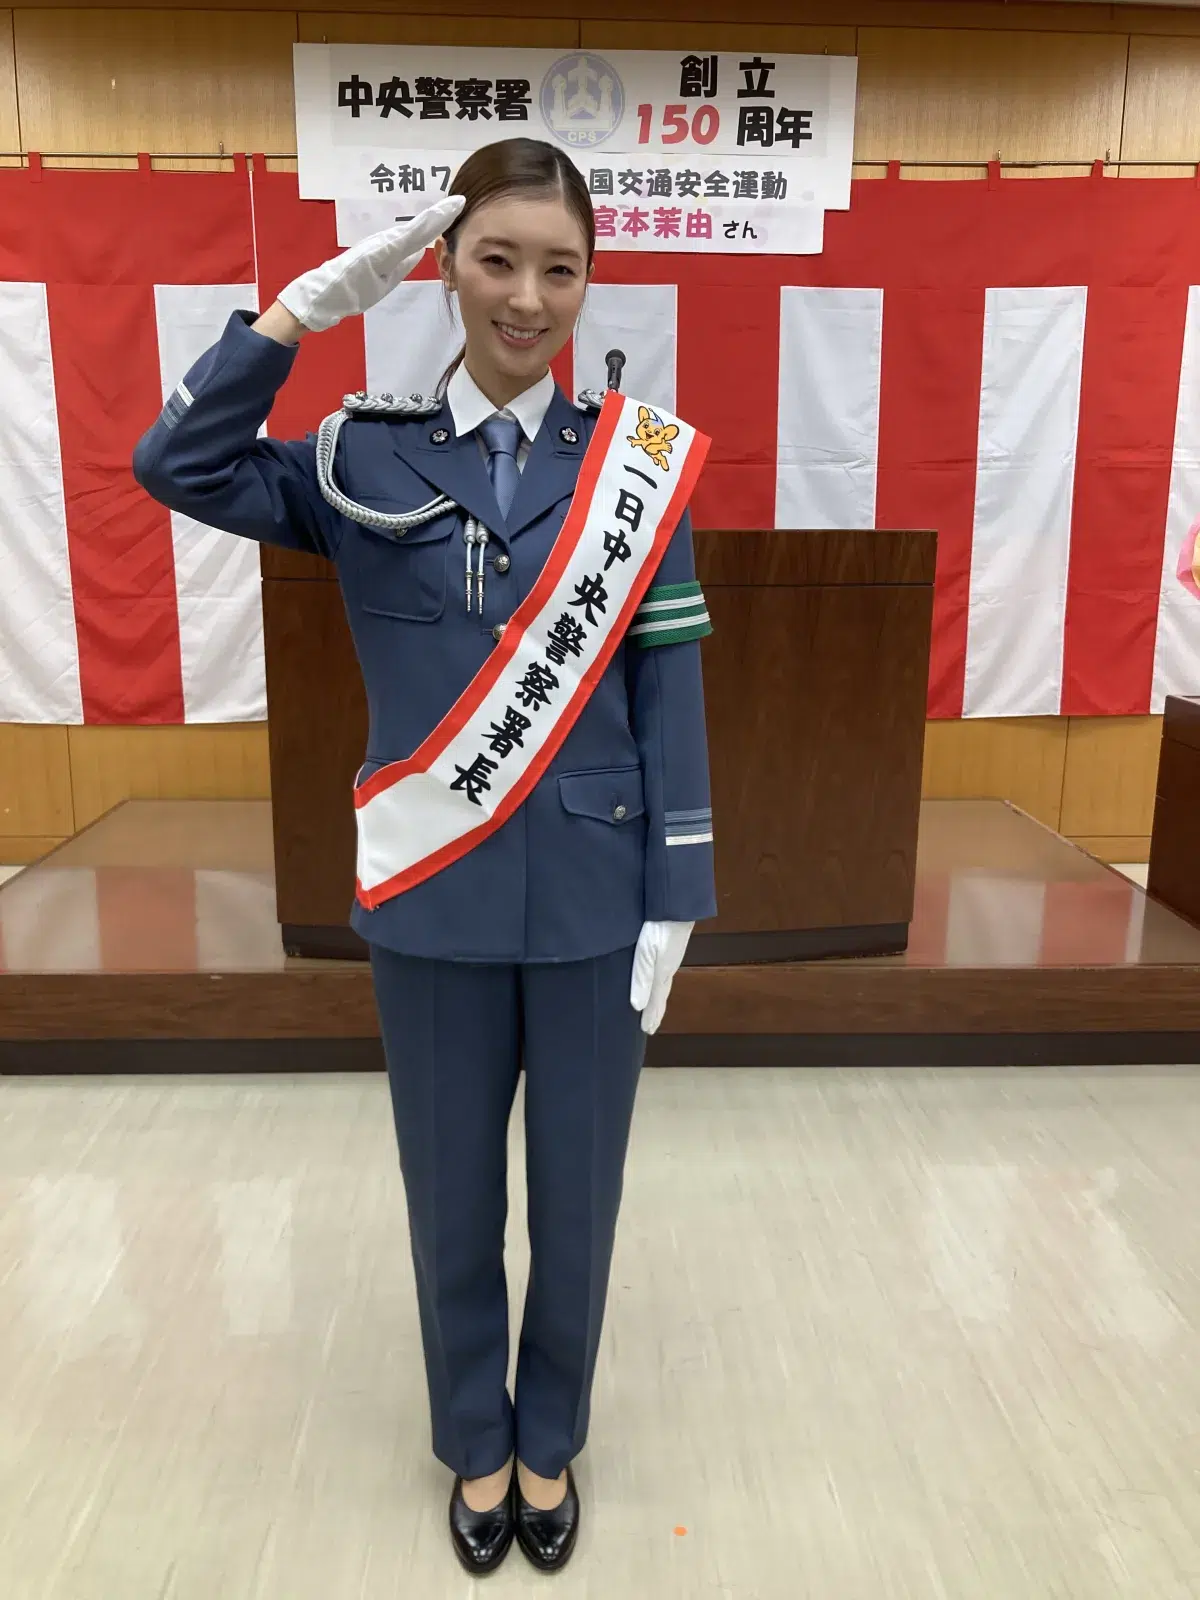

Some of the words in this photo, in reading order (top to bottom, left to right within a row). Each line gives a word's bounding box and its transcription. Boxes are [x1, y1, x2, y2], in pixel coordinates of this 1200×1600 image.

[337, 74, 532, 121] 中央警察署
[679, 55, 775, 98] 創立
[567, 130, 597, 142] CPS
[637, 103, 720, 145] 150
[736, 106, 813, 149] 周年
[589, 168, 788, 200] 国交通安全運動
[593, 205, 713, 239] 宮本茉由
[722, 220, 758, 239] さん
[449, 463, 658, 806] 一日中央警察署長
